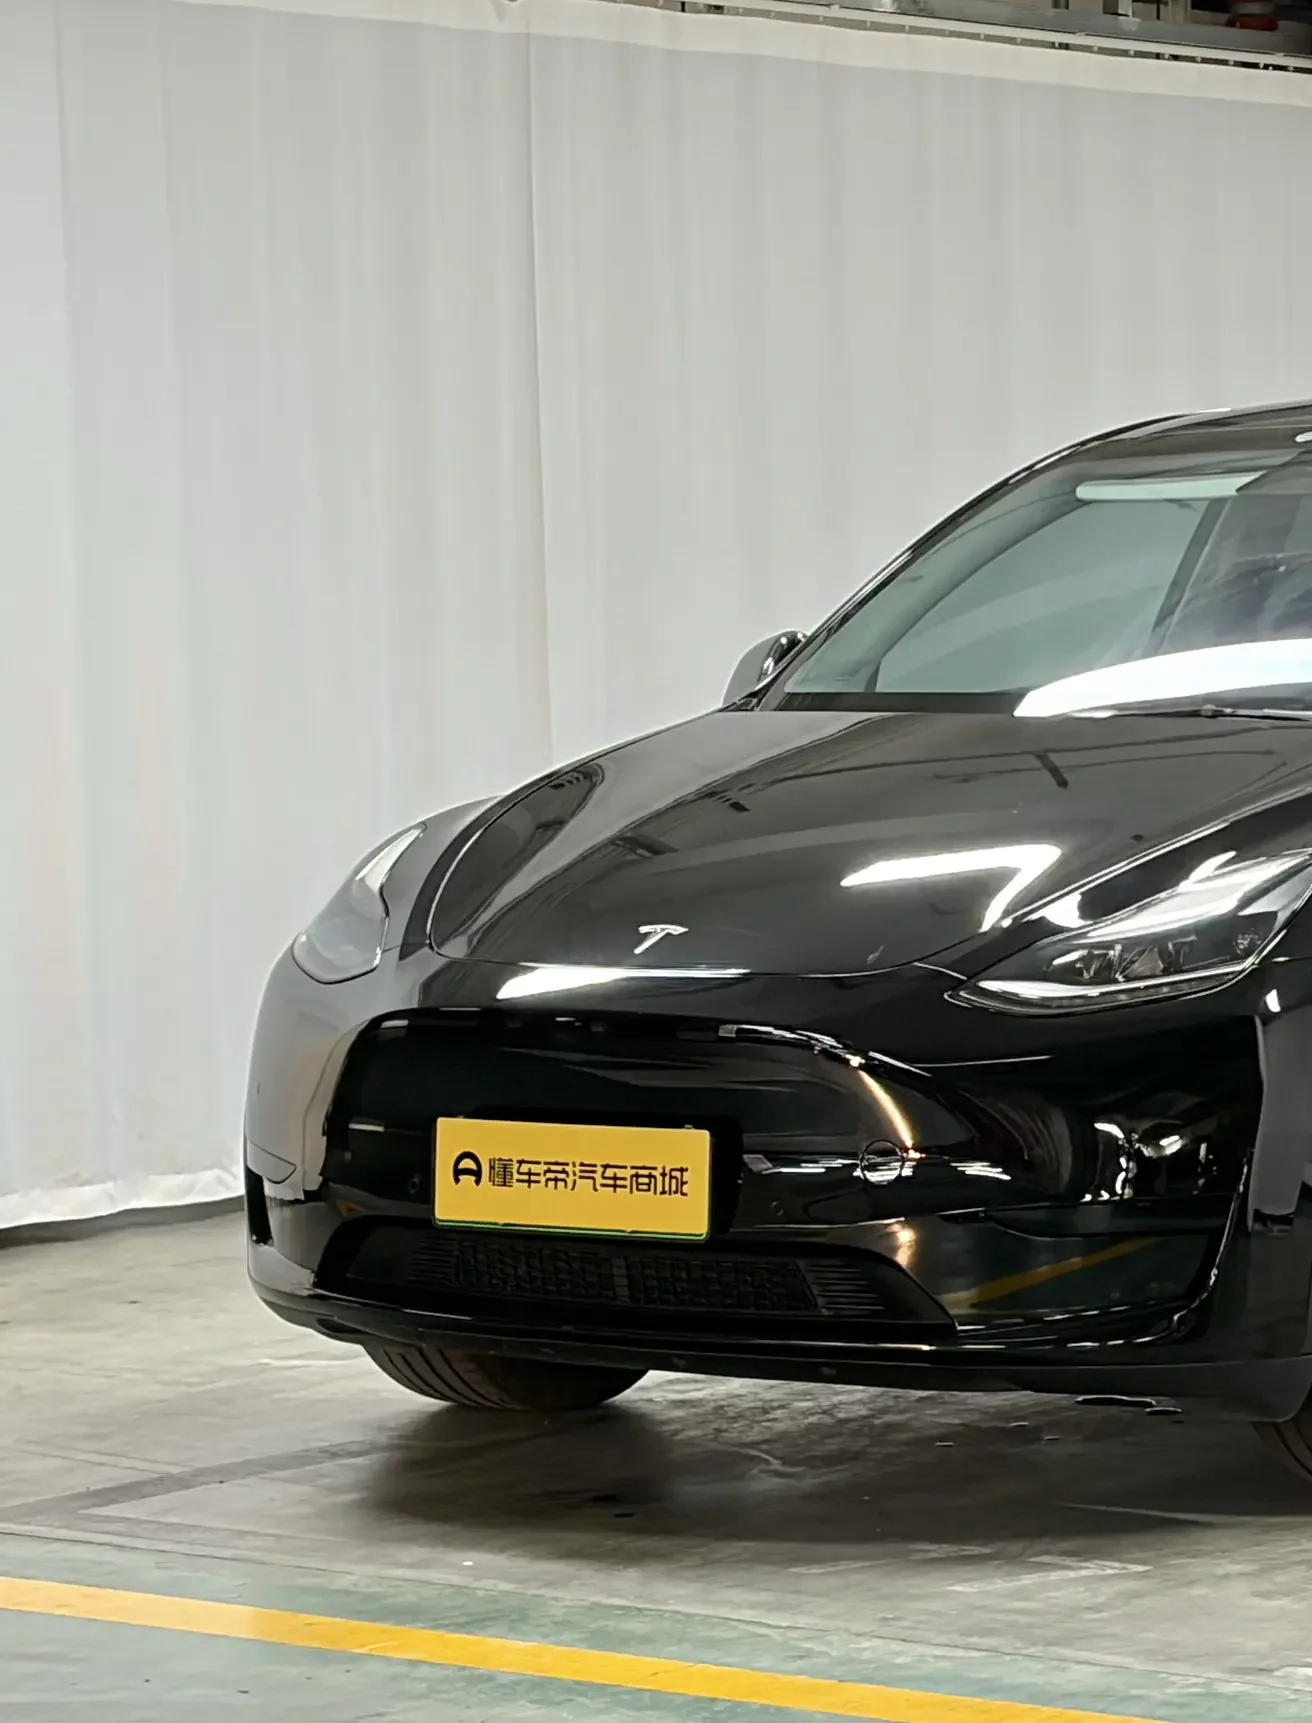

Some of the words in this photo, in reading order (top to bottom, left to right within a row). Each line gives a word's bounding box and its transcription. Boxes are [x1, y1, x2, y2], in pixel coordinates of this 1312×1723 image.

[488, 1157, 689, 1197] 懂车帝汽车商城
